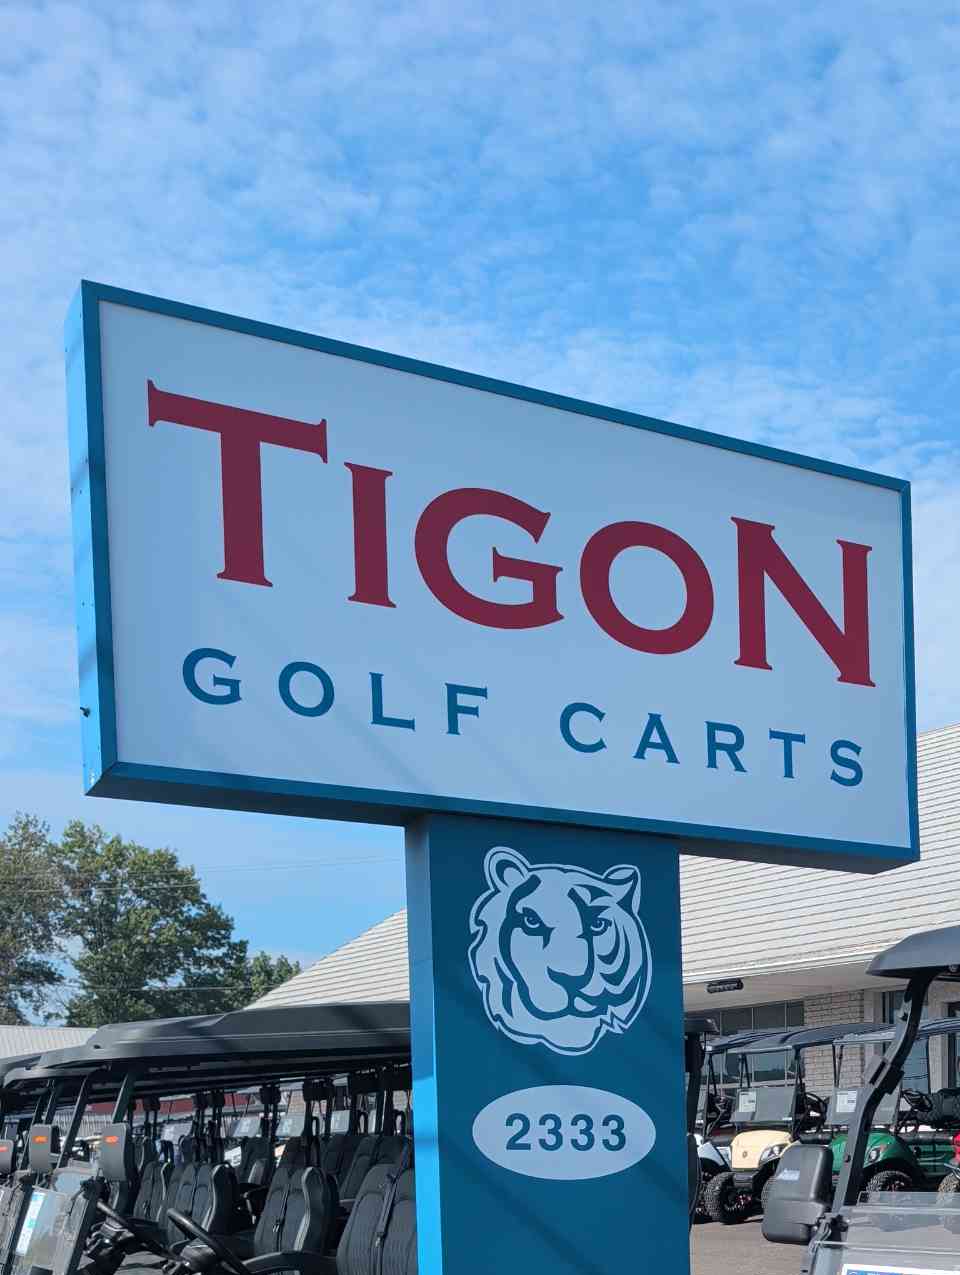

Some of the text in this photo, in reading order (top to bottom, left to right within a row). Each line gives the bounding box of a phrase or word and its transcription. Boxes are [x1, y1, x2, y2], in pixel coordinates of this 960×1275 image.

[147, 379, 875, 687] TIGON
[182, 647, 864, 788] GOLF CARTS
[505, 1113, 626, 1151] 2333
